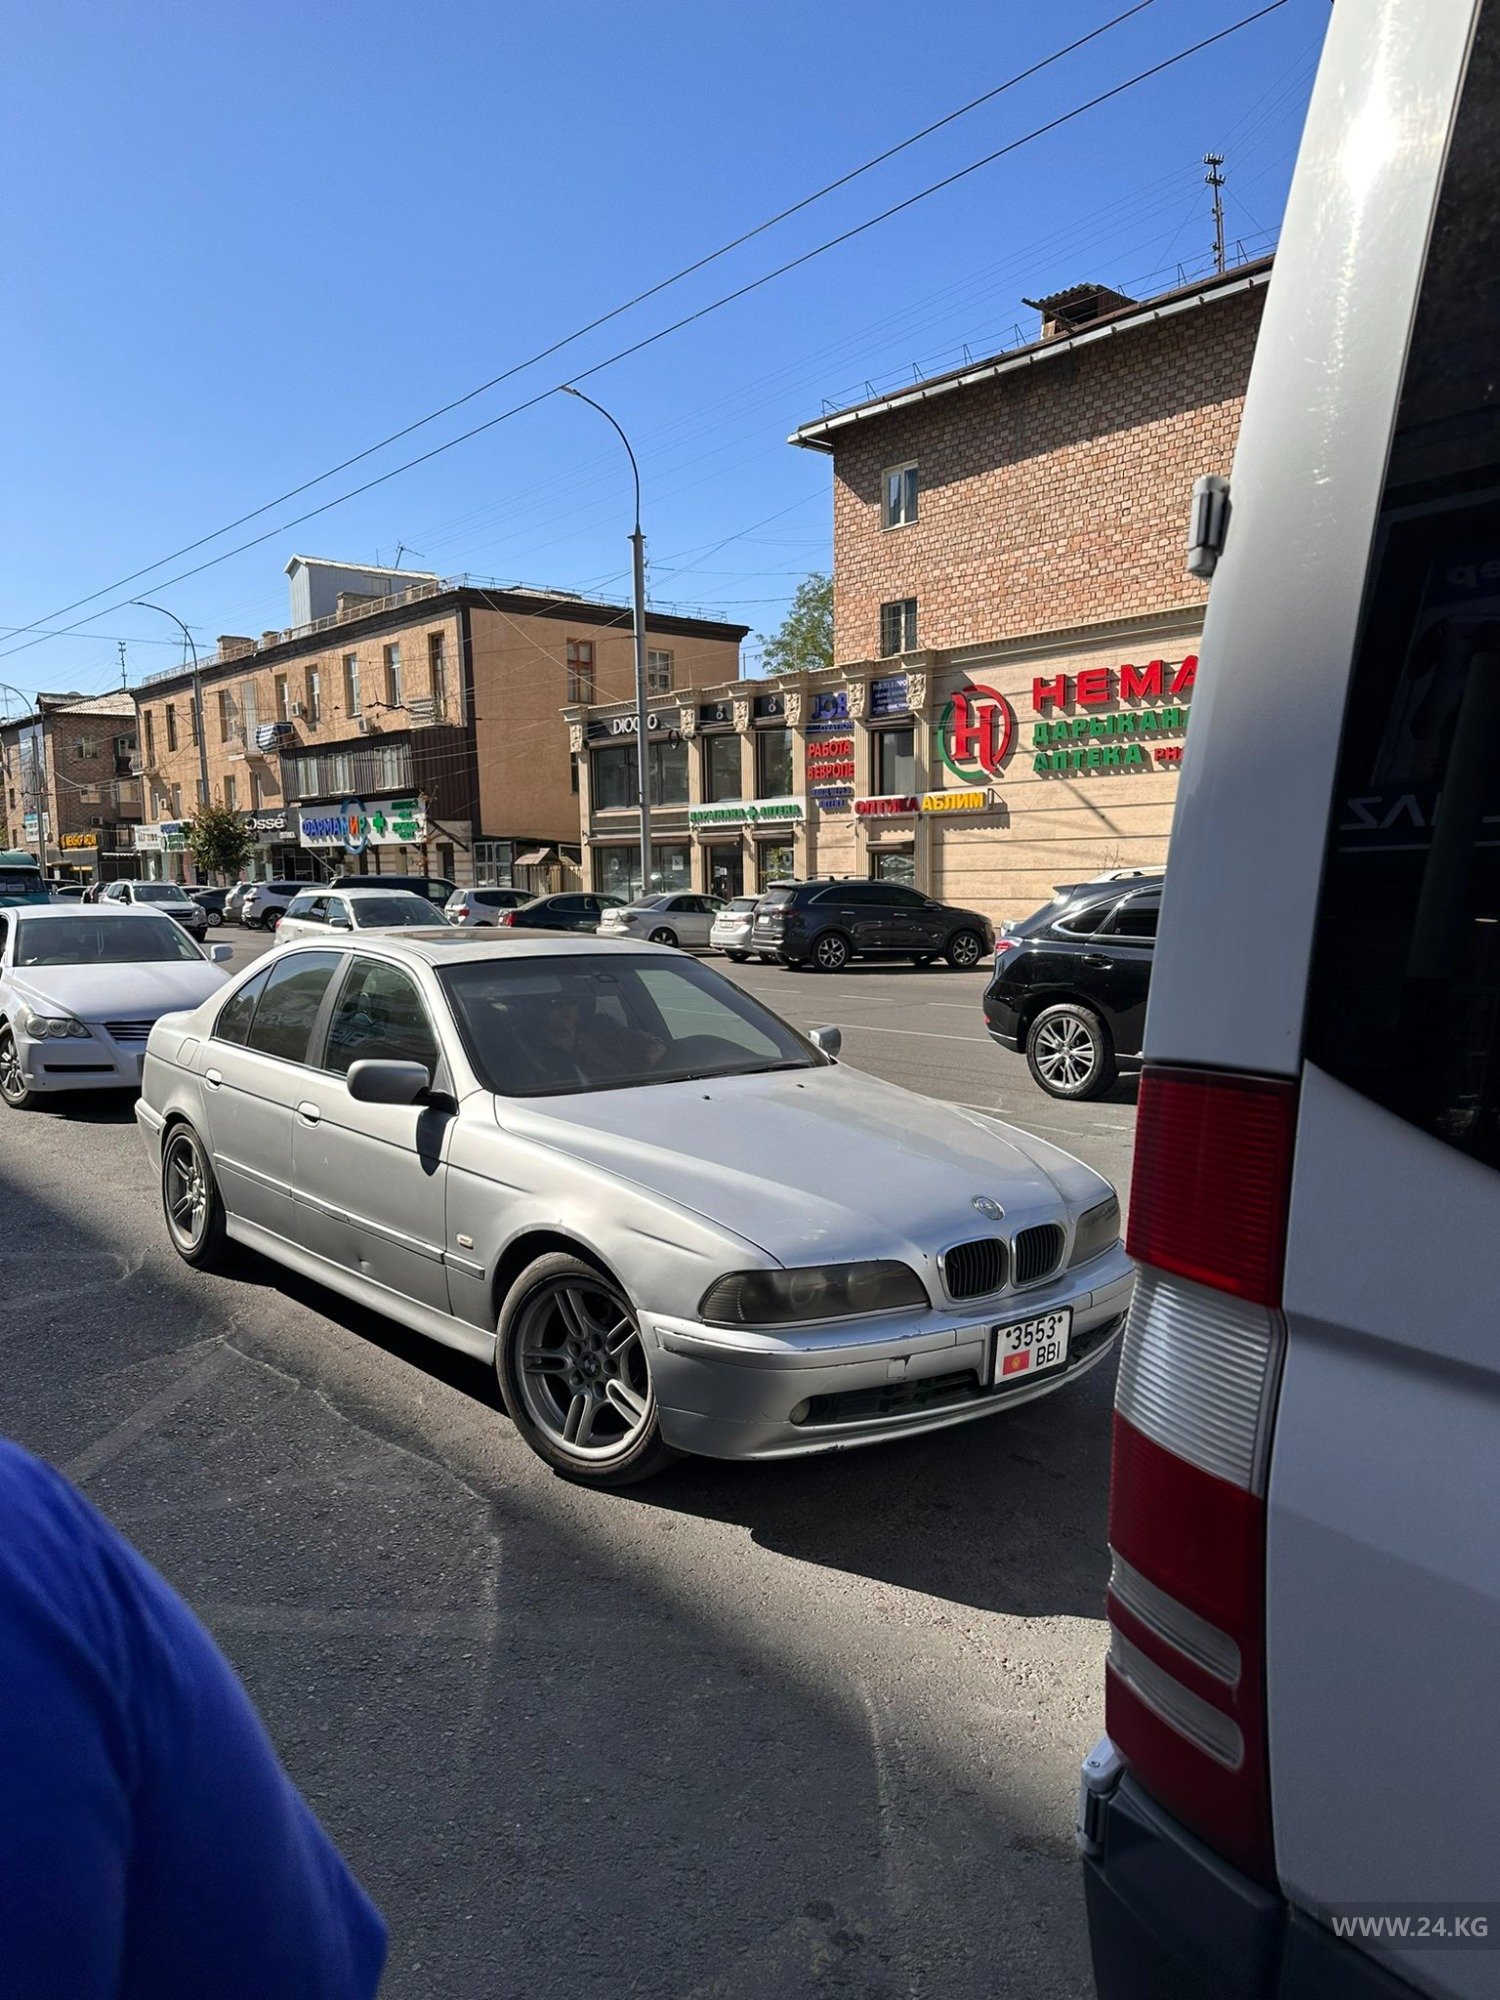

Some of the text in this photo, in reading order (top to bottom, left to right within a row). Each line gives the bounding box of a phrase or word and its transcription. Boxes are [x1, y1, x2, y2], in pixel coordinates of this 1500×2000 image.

[808, 740, 851, 758] РАБОТА
[1033, 744, 1143, 772] АПТЕКА
[760, 804, 802, 818] АПТЕКА
[855, 792, 986, 815] ОПТИКА АБЛИМ
[1011, 1316, 1057, 1350] 3553
[1036, 1341, 1061, 1367] BBI
